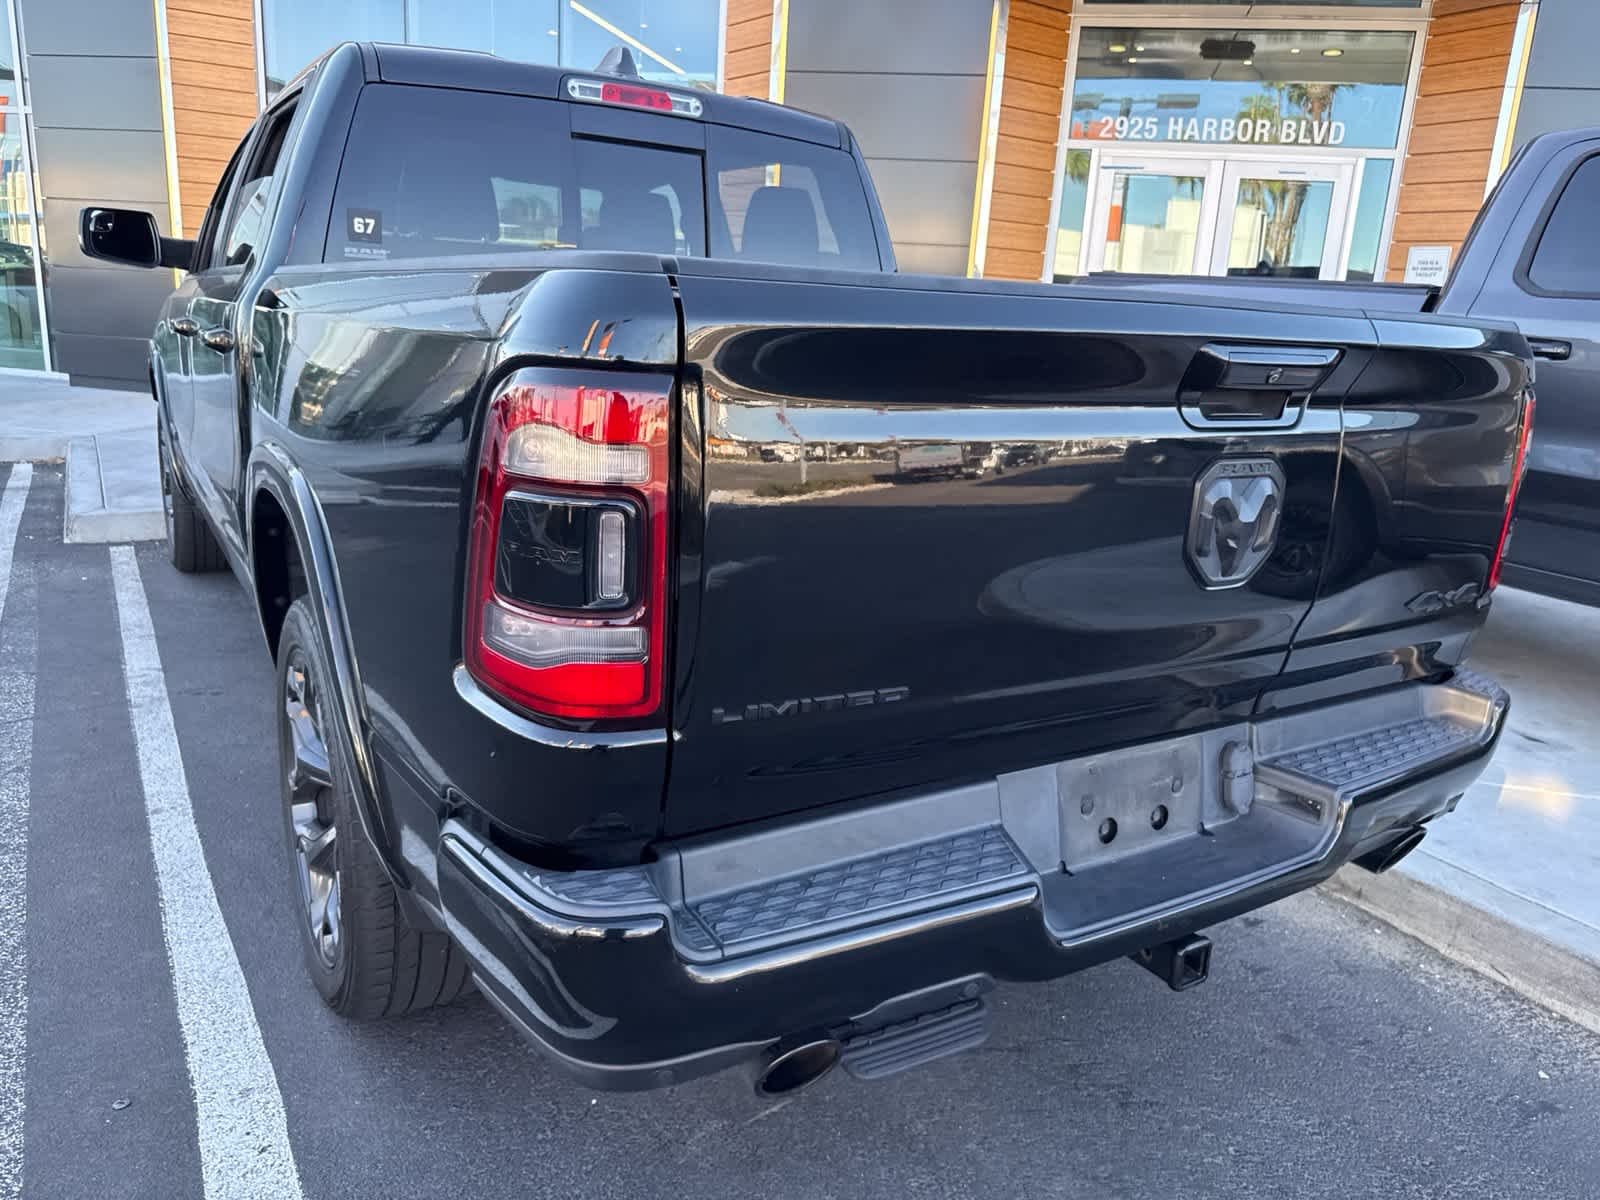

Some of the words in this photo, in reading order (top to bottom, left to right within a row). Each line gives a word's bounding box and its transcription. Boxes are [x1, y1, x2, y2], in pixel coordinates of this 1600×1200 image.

[1100, 116, 1158, 139] 2925
[1167, 117, 1271, 142] HARBOR
[1280, 119, 1345, 144] BLVD
[353, 217, 376, 234] 67
[711, 686, 909, 723] LIMITED
